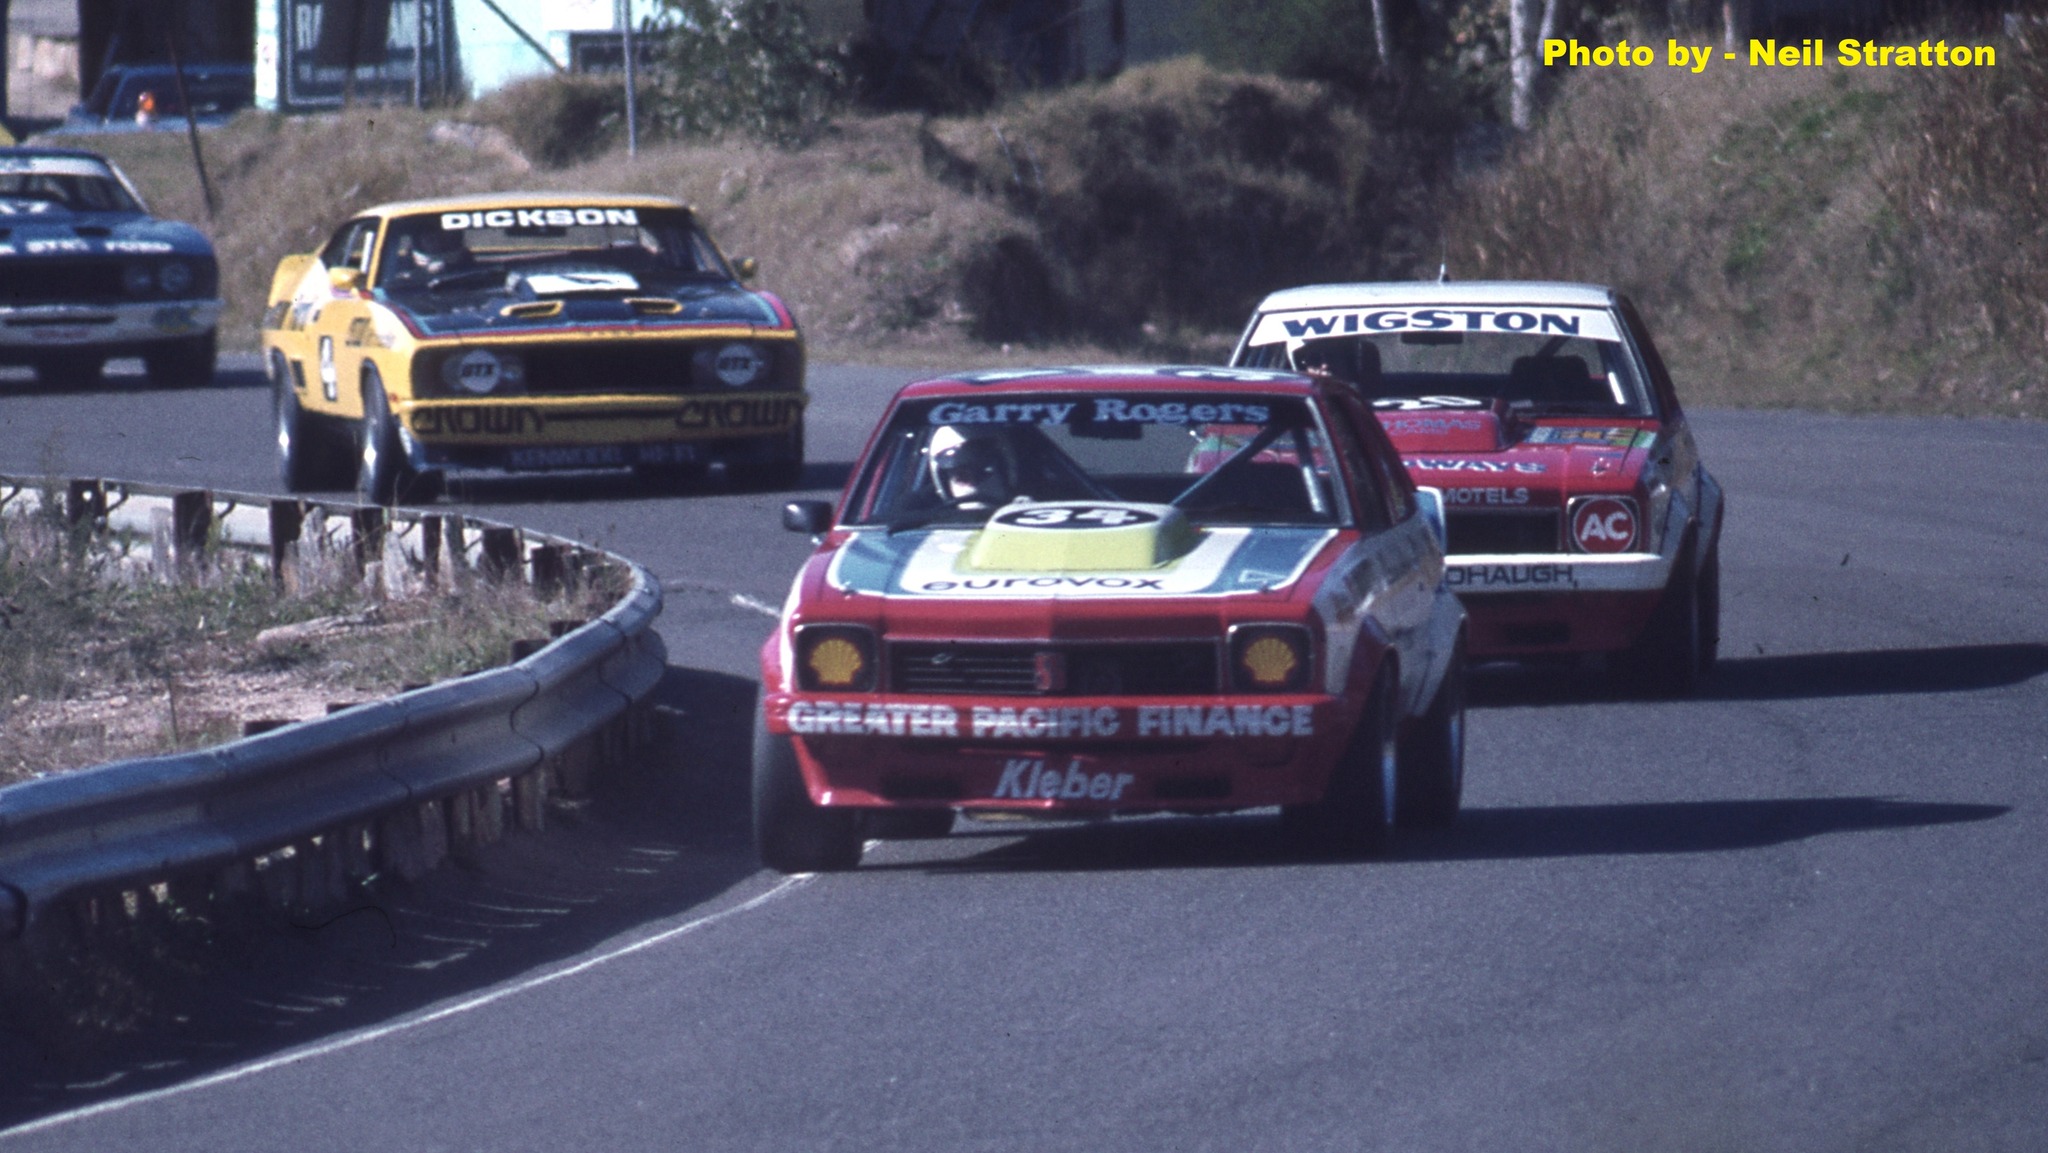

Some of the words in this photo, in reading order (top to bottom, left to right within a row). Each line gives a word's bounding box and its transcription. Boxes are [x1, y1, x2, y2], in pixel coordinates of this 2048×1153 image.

[441, 208, 639, 230] DICKSON
[1282, 310, 1580, 337] WIGSTON
[928, 401, 1078, 427] Garry
[1093, 398, 1270, 425] Rogers
[1372, 395, 1482, 411] 20
[1015, 508, 1138, 526] 34
[1580, 510, 1630, 542] AC
[922, 576, 1164, 592] eurovox
[788, 701, 959, 738] GREATER
[971, 704, 1120, 738] PACIFIC
[1137, 703, 1314, 736] FINANCE
[993, 758, 1135, 801] Kleber
